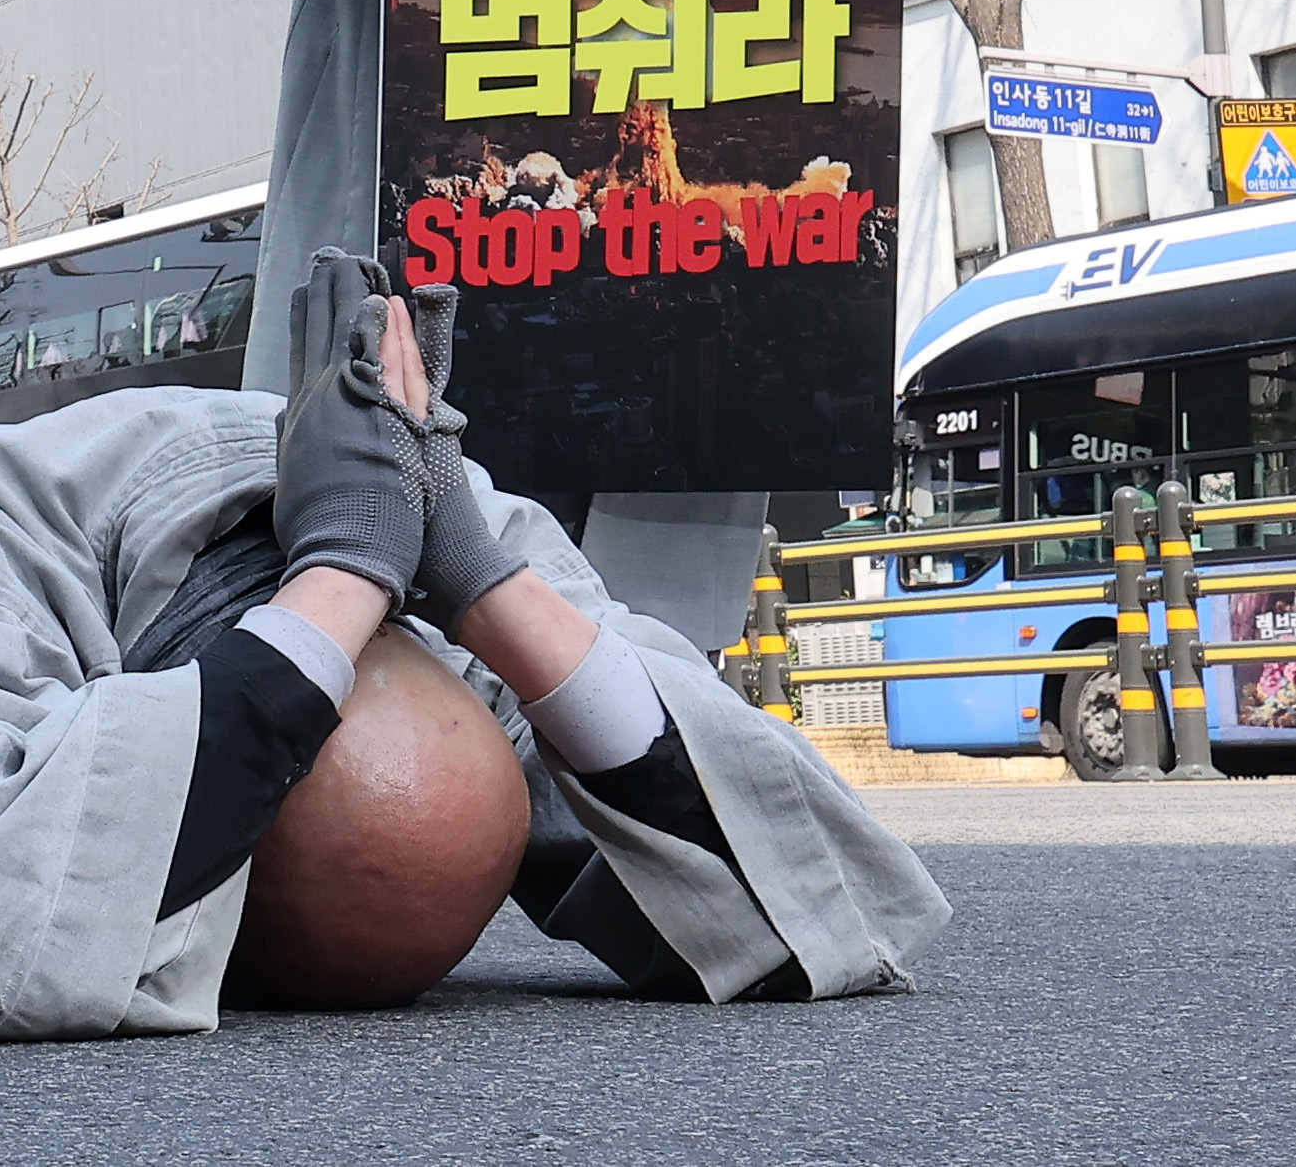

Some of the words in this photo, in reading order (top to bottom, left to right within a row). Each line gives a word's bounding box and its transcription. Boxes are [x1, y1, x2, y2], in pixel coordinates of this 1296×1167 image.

[992, 81, 1092, 115] 인사동11길
[993, 110, 1048, 134] Insadong
[405, 197, 580, 287] Stop
[597, 187, 722, 278] the
[741, 189, 875, 268] war
[1065, 238, 1164, 298] EV
[936, 409, 979, 435] 2201
